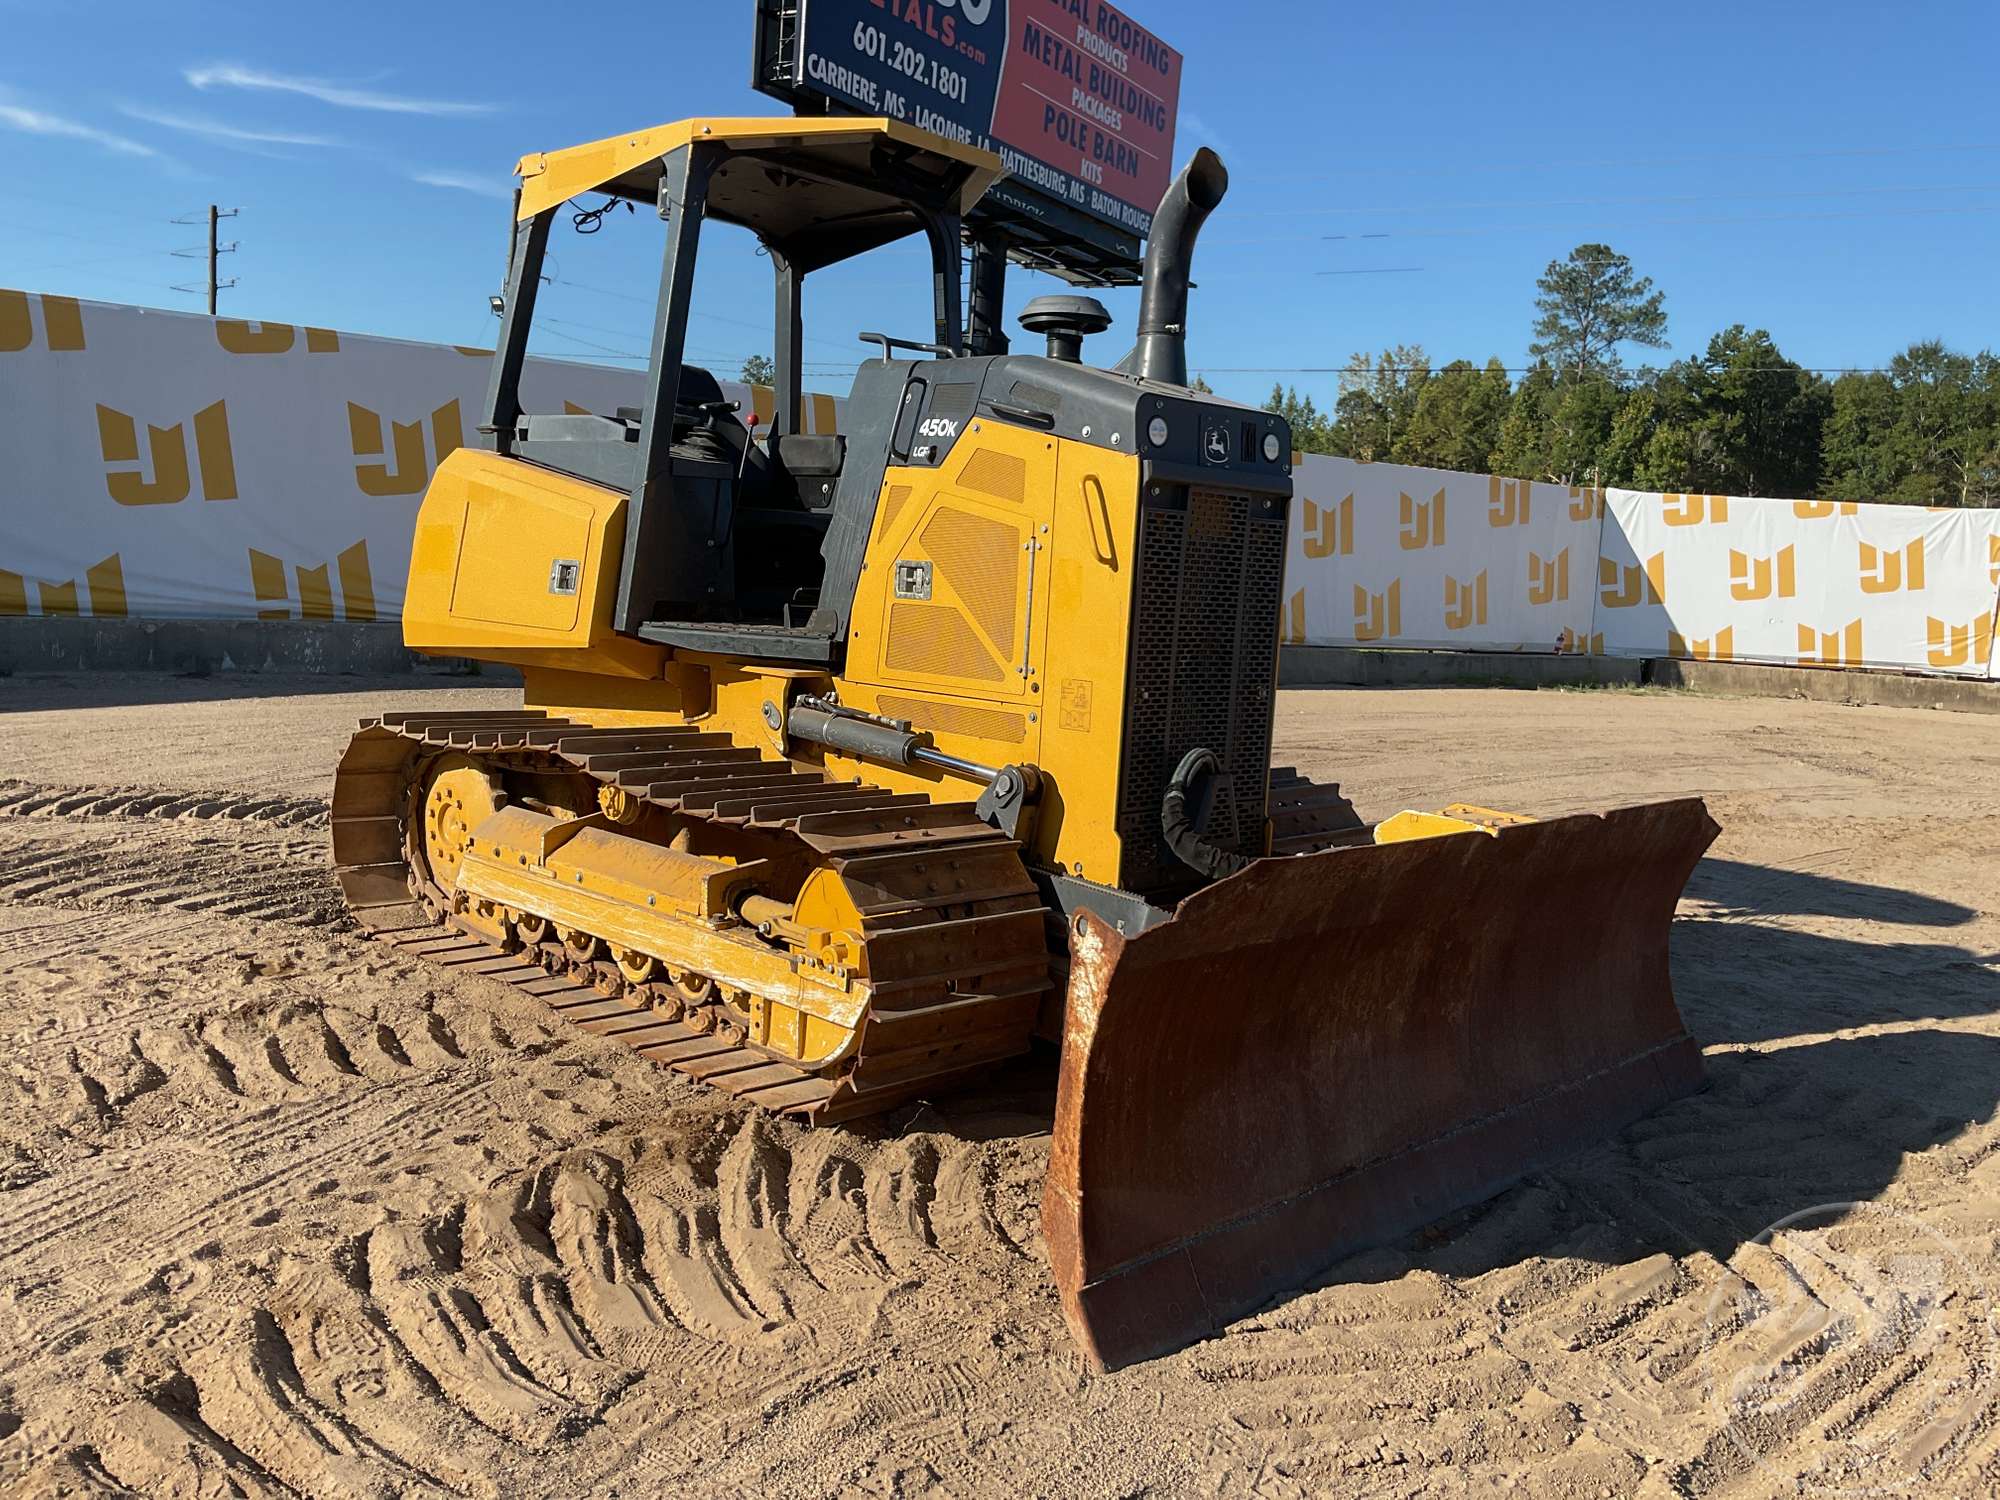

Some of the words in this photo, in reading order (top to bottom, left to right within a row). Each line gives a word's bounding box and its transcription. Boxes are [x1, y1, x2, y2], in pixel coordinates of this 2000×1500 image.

[853, 20, 967, 104] 601.202.1801
[869, 0, 987, 65] ALS.com
[1076, 24, 1129, 73] PRODUCTS
[1097, 4, 1169, 76] ROOFING
[1023, 23, 1082, 84] METAL
[1089, 63, 1166, 133] BUILDING
[1071, 87, 1122, 131] PACKAGES
[807, 53, 881, 112] CARRIERE,
[883, 90, 905, 119] MS
[1000, 146, 1069, 200] HATTIESBURG,
[1069, 180, 1086, 204] MS
[1091, 190, 1122, 220] BATON
[1043, 103, 1088, 153] POLE
[1093, 131, 1139, 178] BARN
[1080, 158, 1103, 185] KITS
[919, 418, 959, 437] 450K
